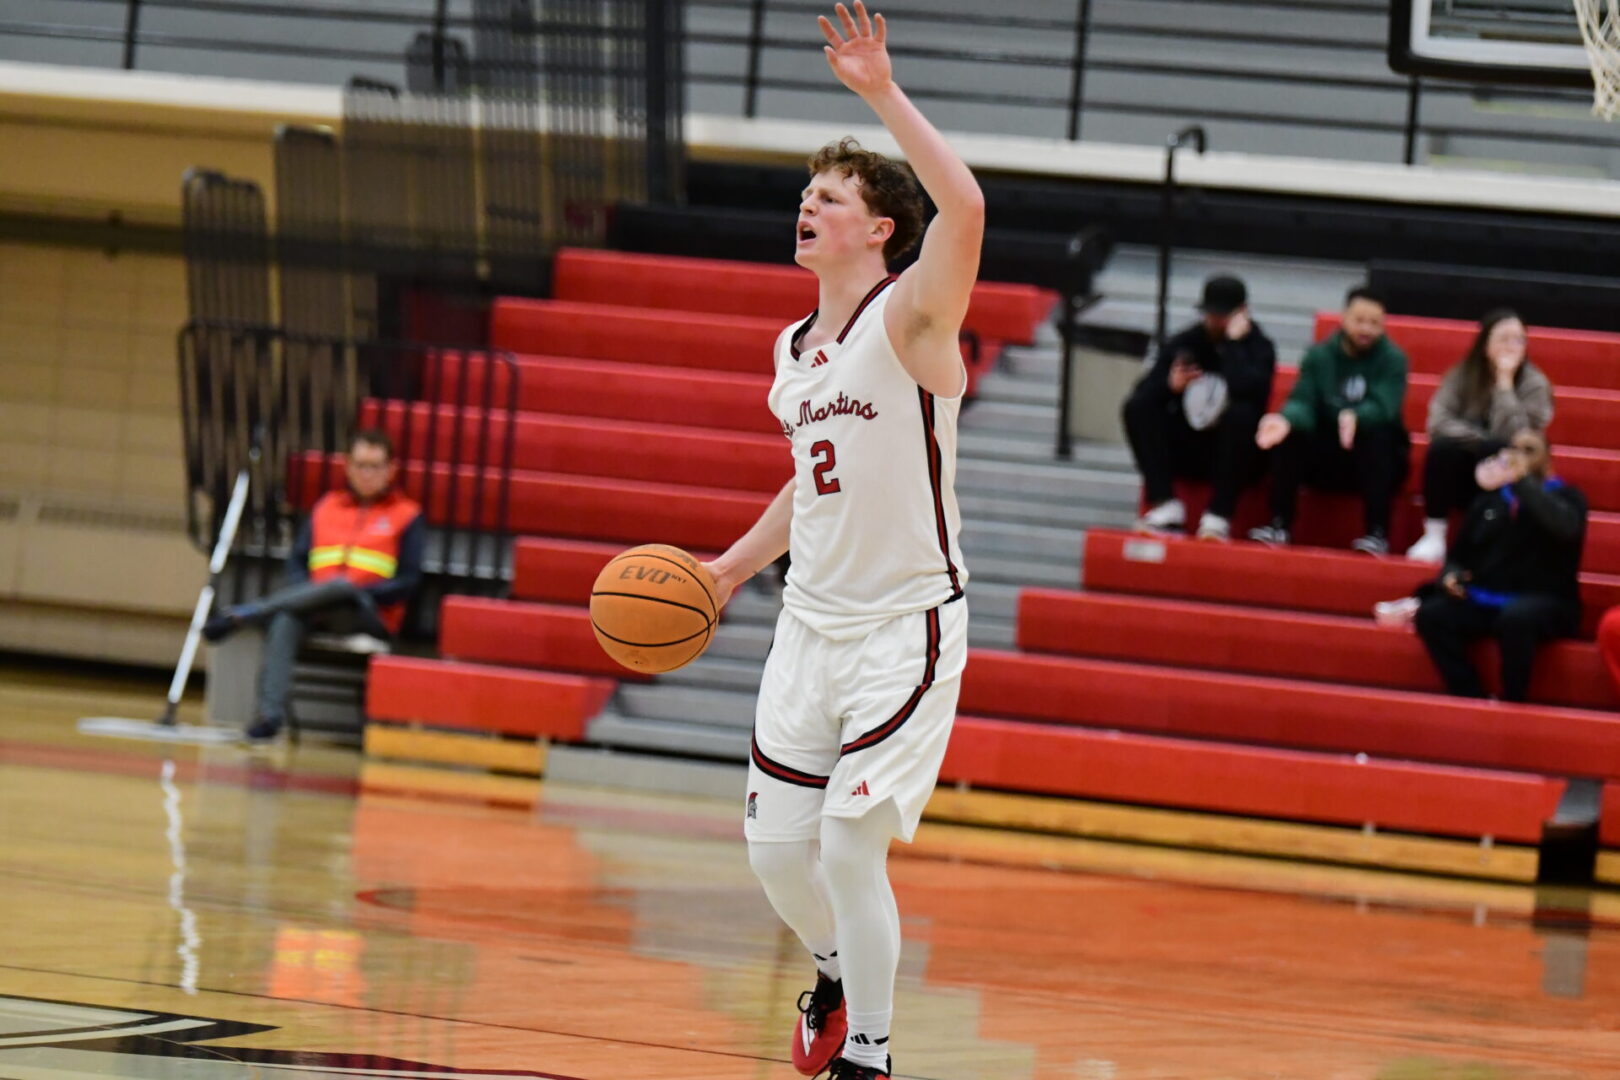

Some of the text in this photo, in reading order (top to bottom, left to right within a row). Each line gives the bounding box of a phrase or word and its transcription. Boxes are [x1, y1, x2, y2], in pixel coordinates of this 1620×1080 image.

[796, 391, 878, 426] Martins
[810, 439, 841, 496] 2
[619, 565, 671, 584] EVO
